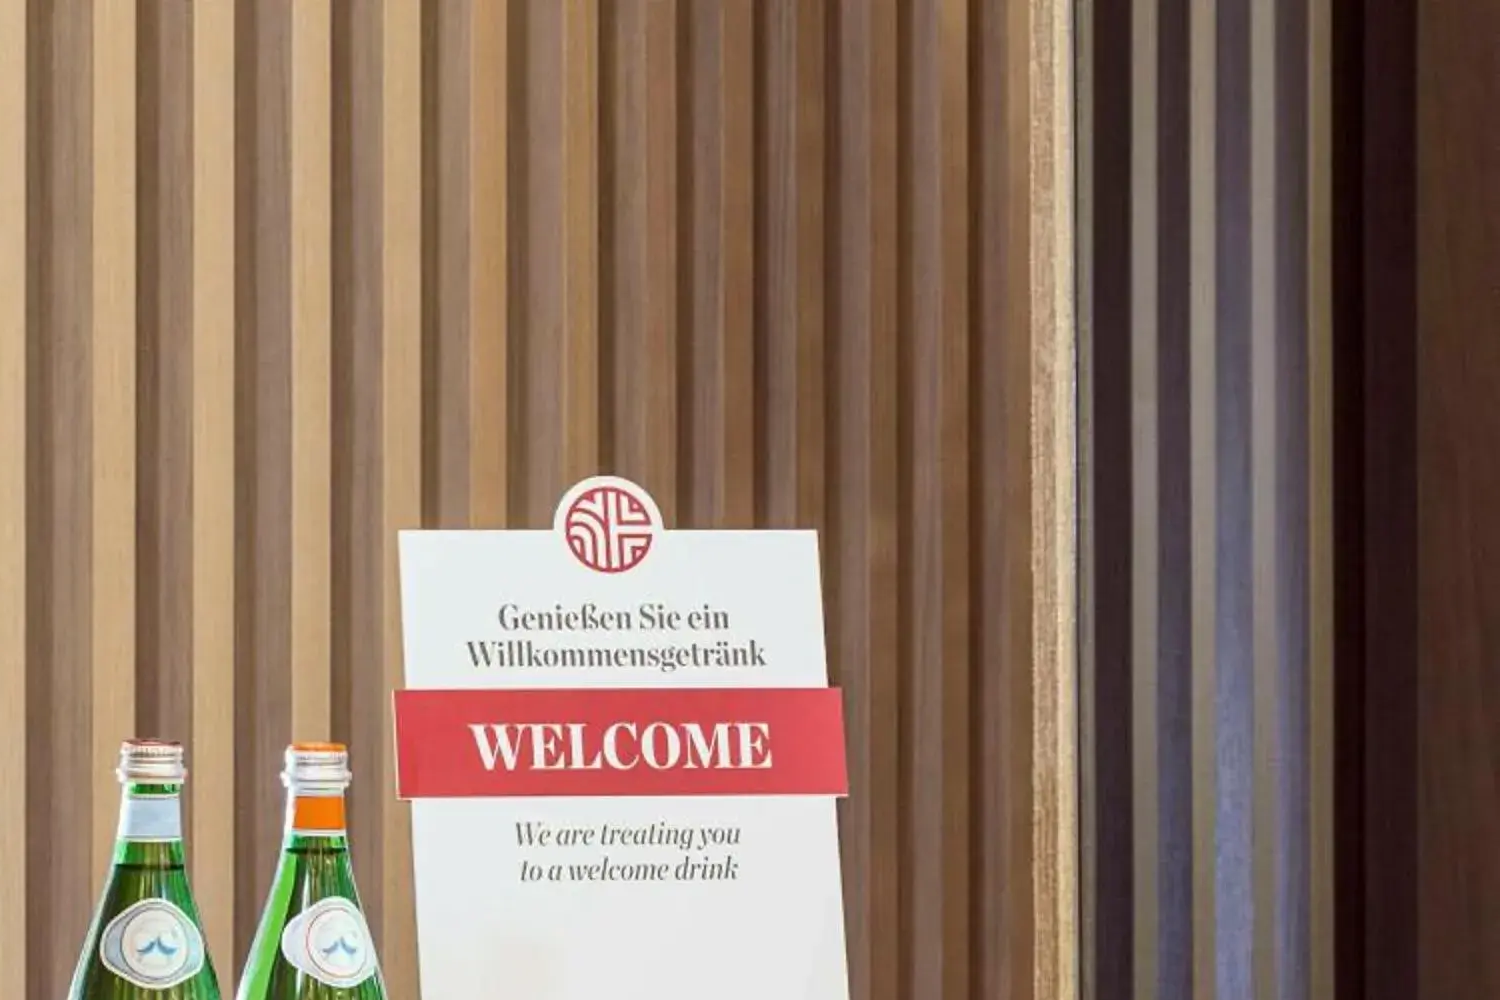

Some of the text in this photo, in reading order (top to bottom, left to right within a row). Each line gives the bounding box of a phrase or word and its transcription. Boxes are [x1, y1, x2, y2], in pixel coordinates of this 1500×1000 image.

[498, 603, 730, 631] Genießen Sie ein
[466, 639, 767, 673] Willkommensgetränk
[468, 721, 773, 771] WELCOME
[515, 821, 741, 851] We are treating you
[520, 855, 739, 883] to a welcome drink
